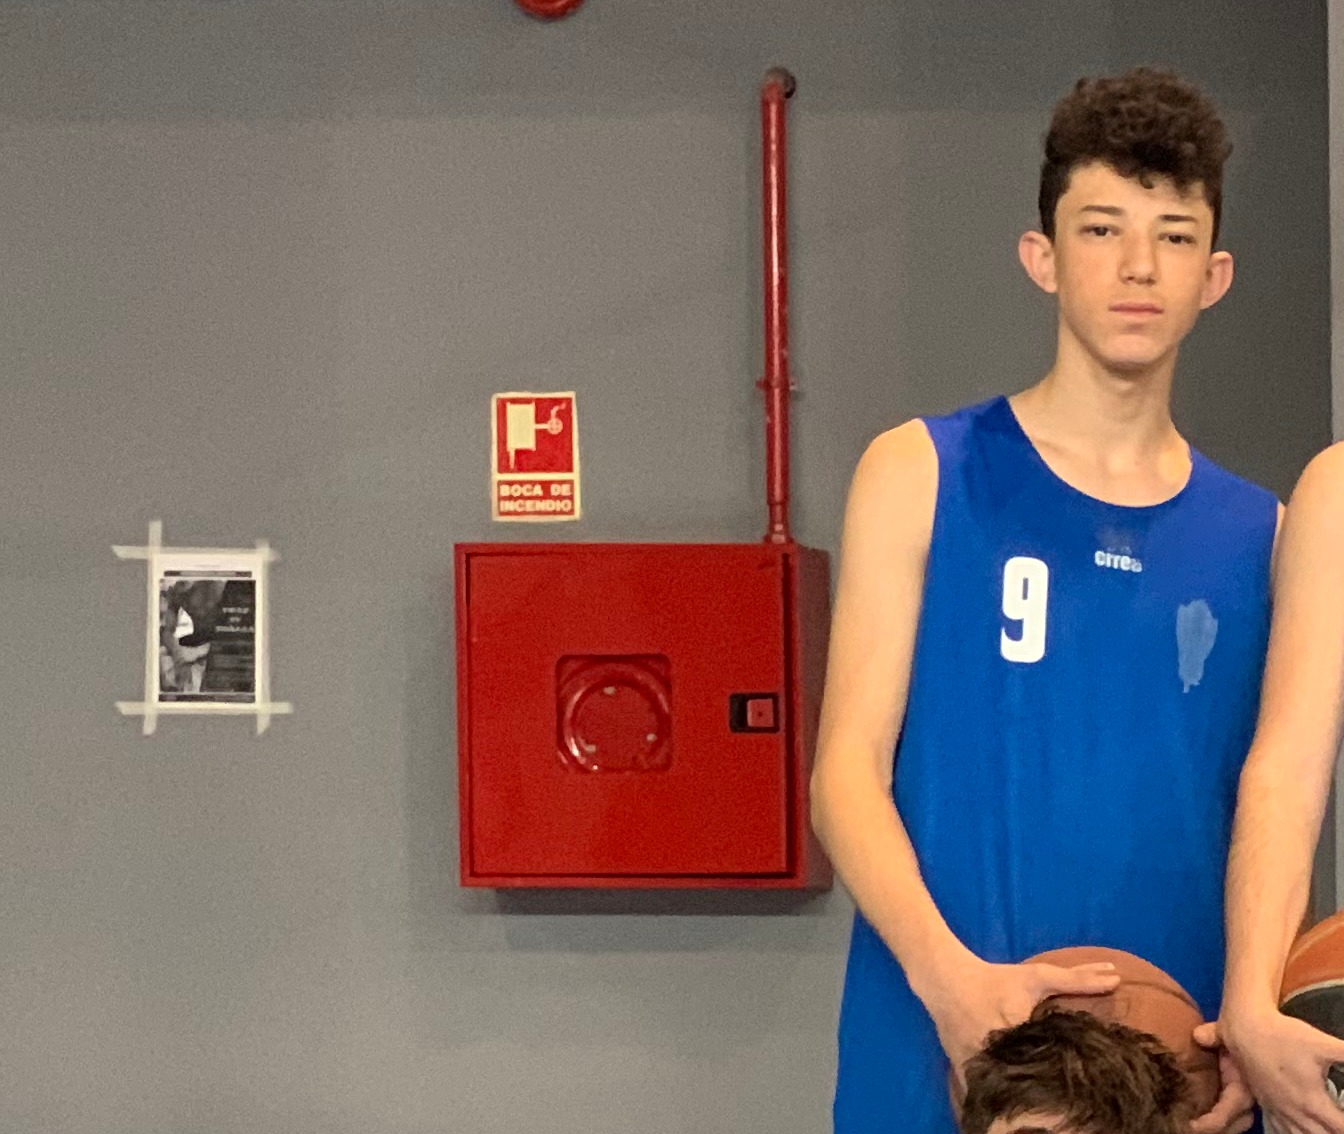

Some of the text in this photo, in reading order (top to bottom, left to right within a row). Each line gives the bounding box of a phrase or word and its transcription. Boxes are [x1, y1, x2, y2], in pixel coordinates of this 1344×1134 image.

[500, 483, 572, 497] BOCA DE
[500, 499, 572, 513] INCENDIO
[1001, 556, 1050, 664] 9
